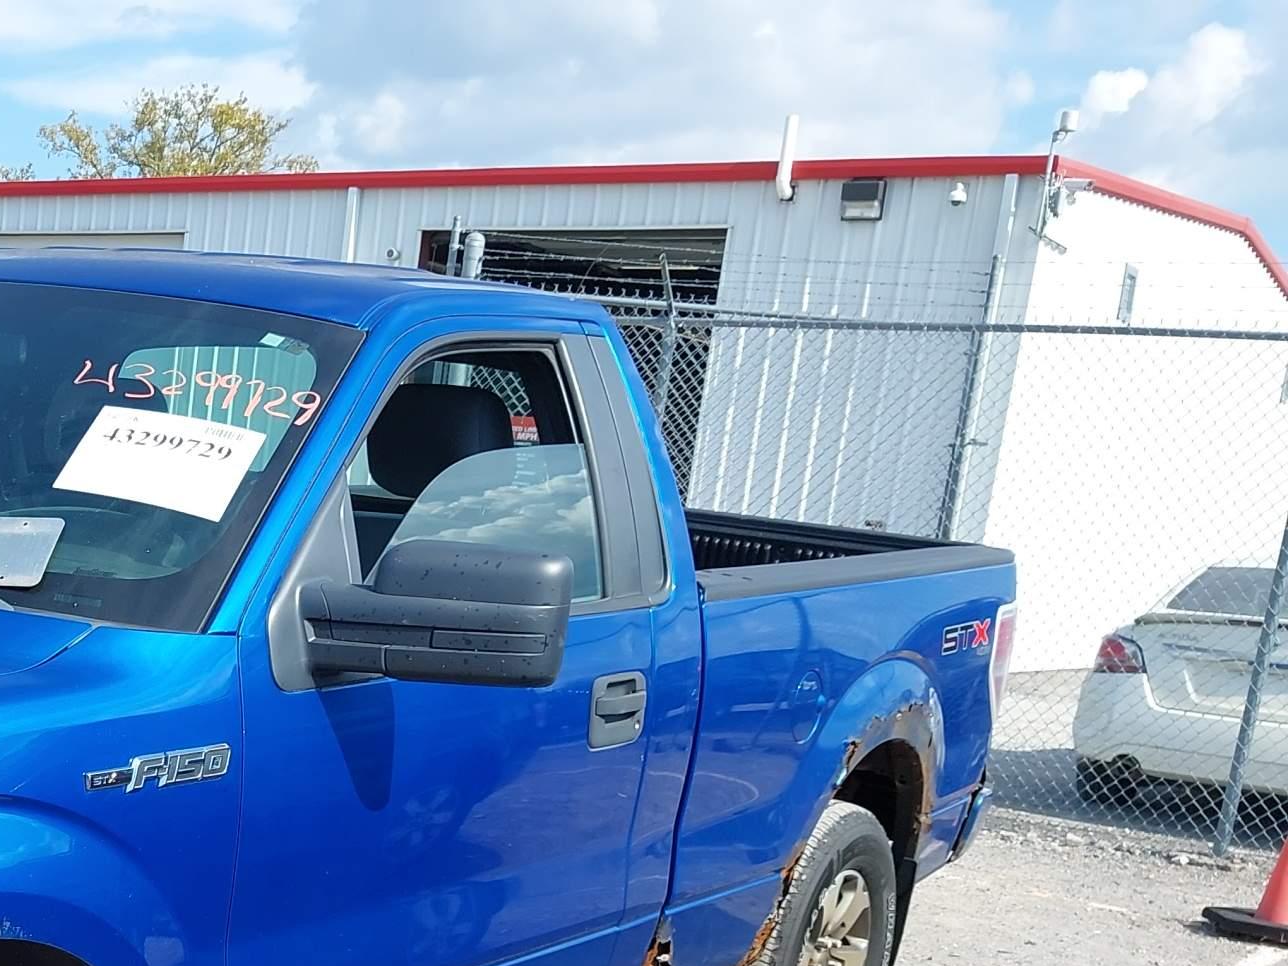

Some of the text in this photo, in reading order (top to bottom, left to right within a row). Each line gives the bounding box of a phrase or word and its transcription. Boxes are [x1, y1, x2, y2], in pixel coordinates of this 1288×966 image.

[73, 360, 321, 426] 43299729
[103, 426, 233, 462] 43299729
[941, 618, 992, 656] STX
[93, 743, 232, 793] STX F-150
